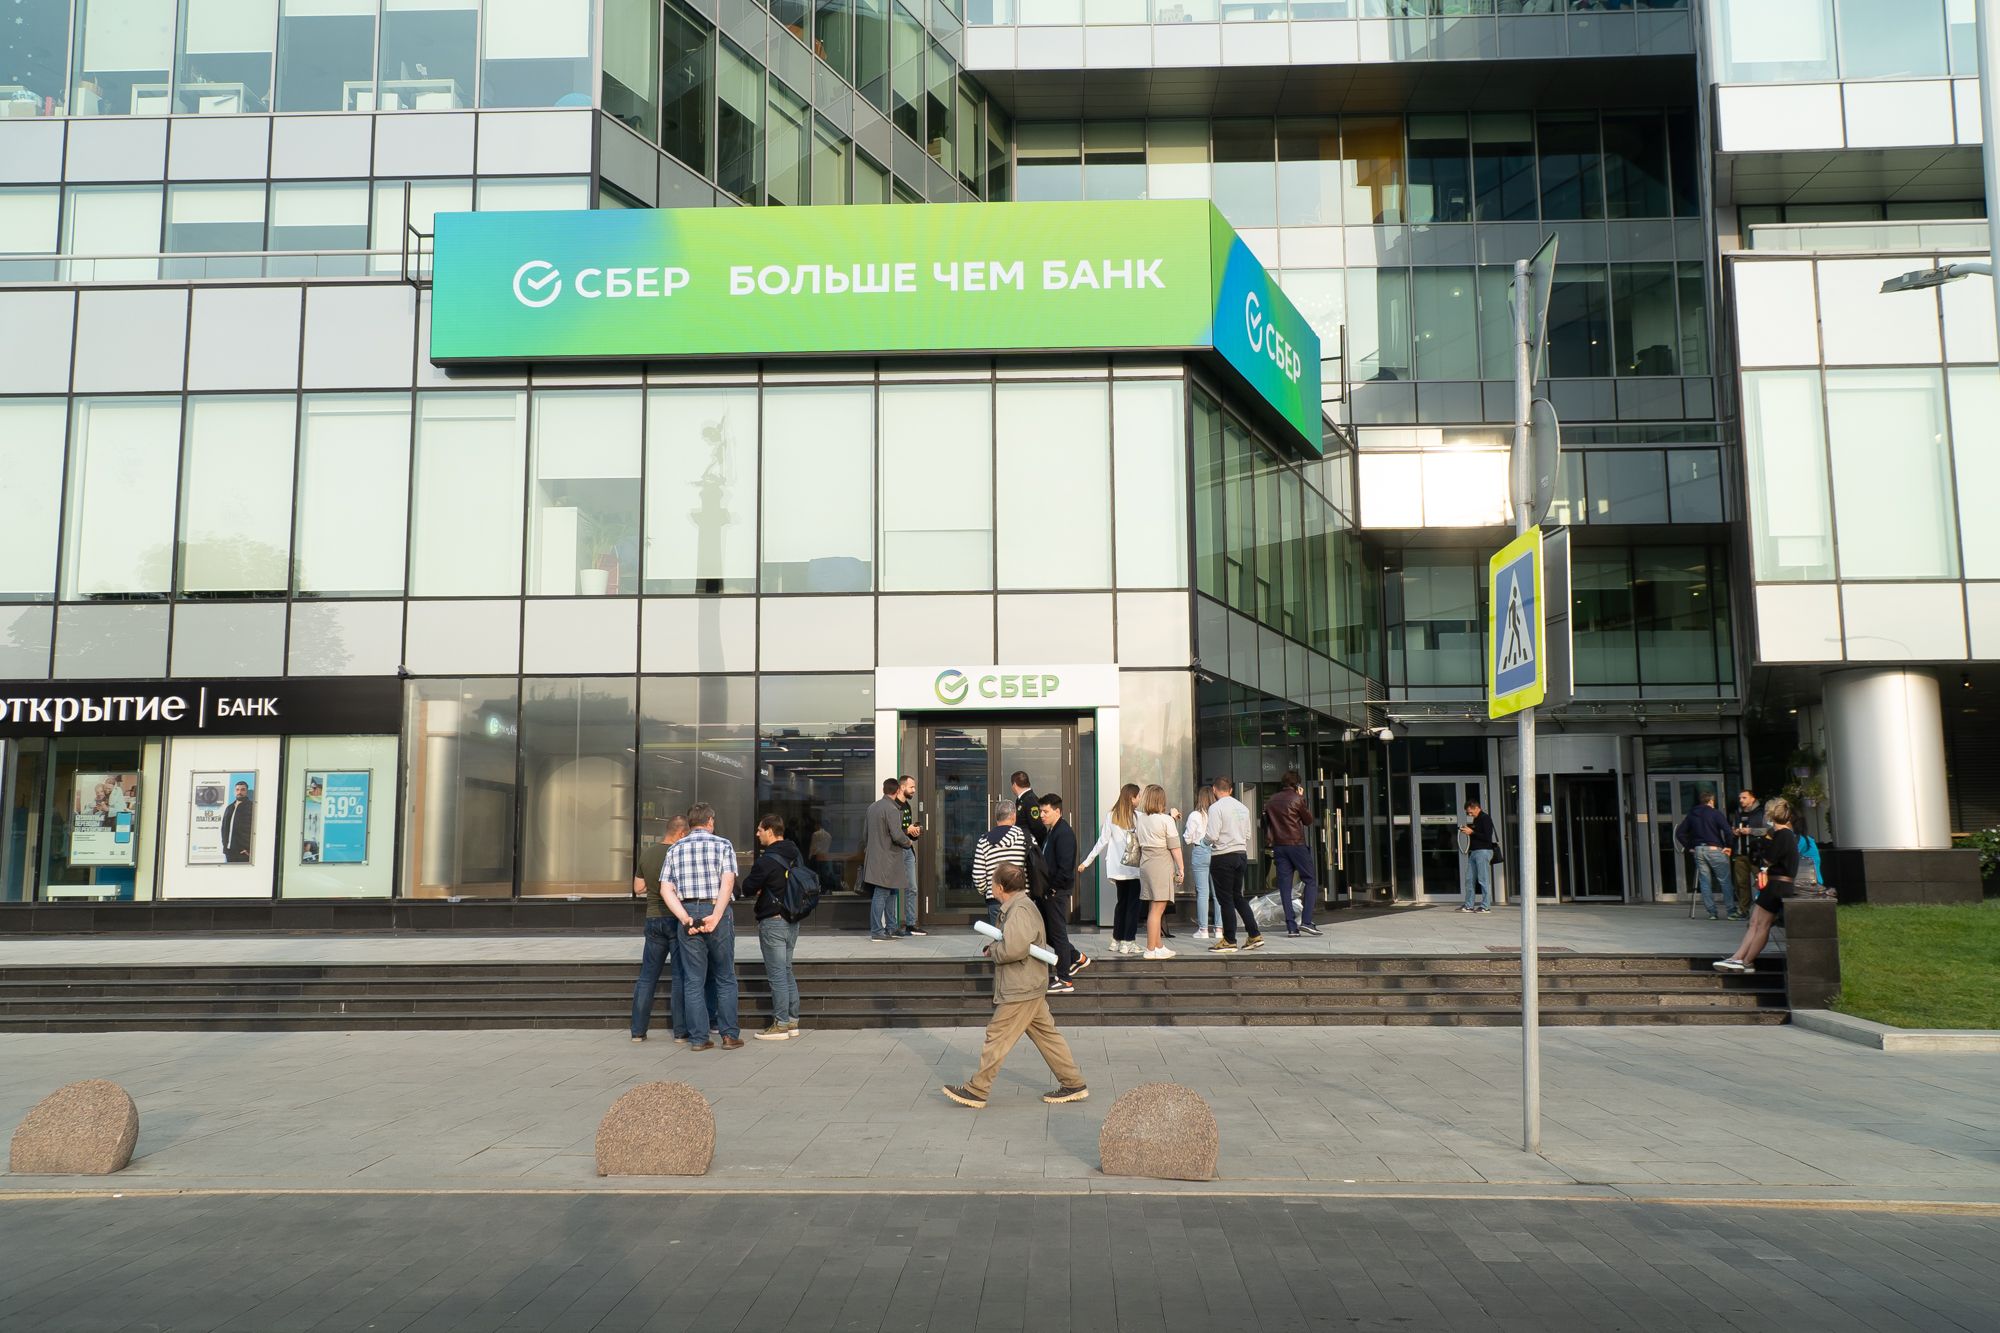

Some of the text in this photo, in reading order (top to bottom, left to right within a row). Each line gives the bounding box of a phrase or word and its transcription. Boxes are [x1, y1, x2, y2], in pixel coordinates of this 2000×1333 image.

[575, 266, 691, 299] СБЕР
[729, 258, 1166, 296] БОЛЬШЕ ЧЕМ БАНК
[1266, 323, 1301, 384] СБЕР
[978, 674, 1060, 698] СБЕР
[216, 697, 280, 717] БАНК
